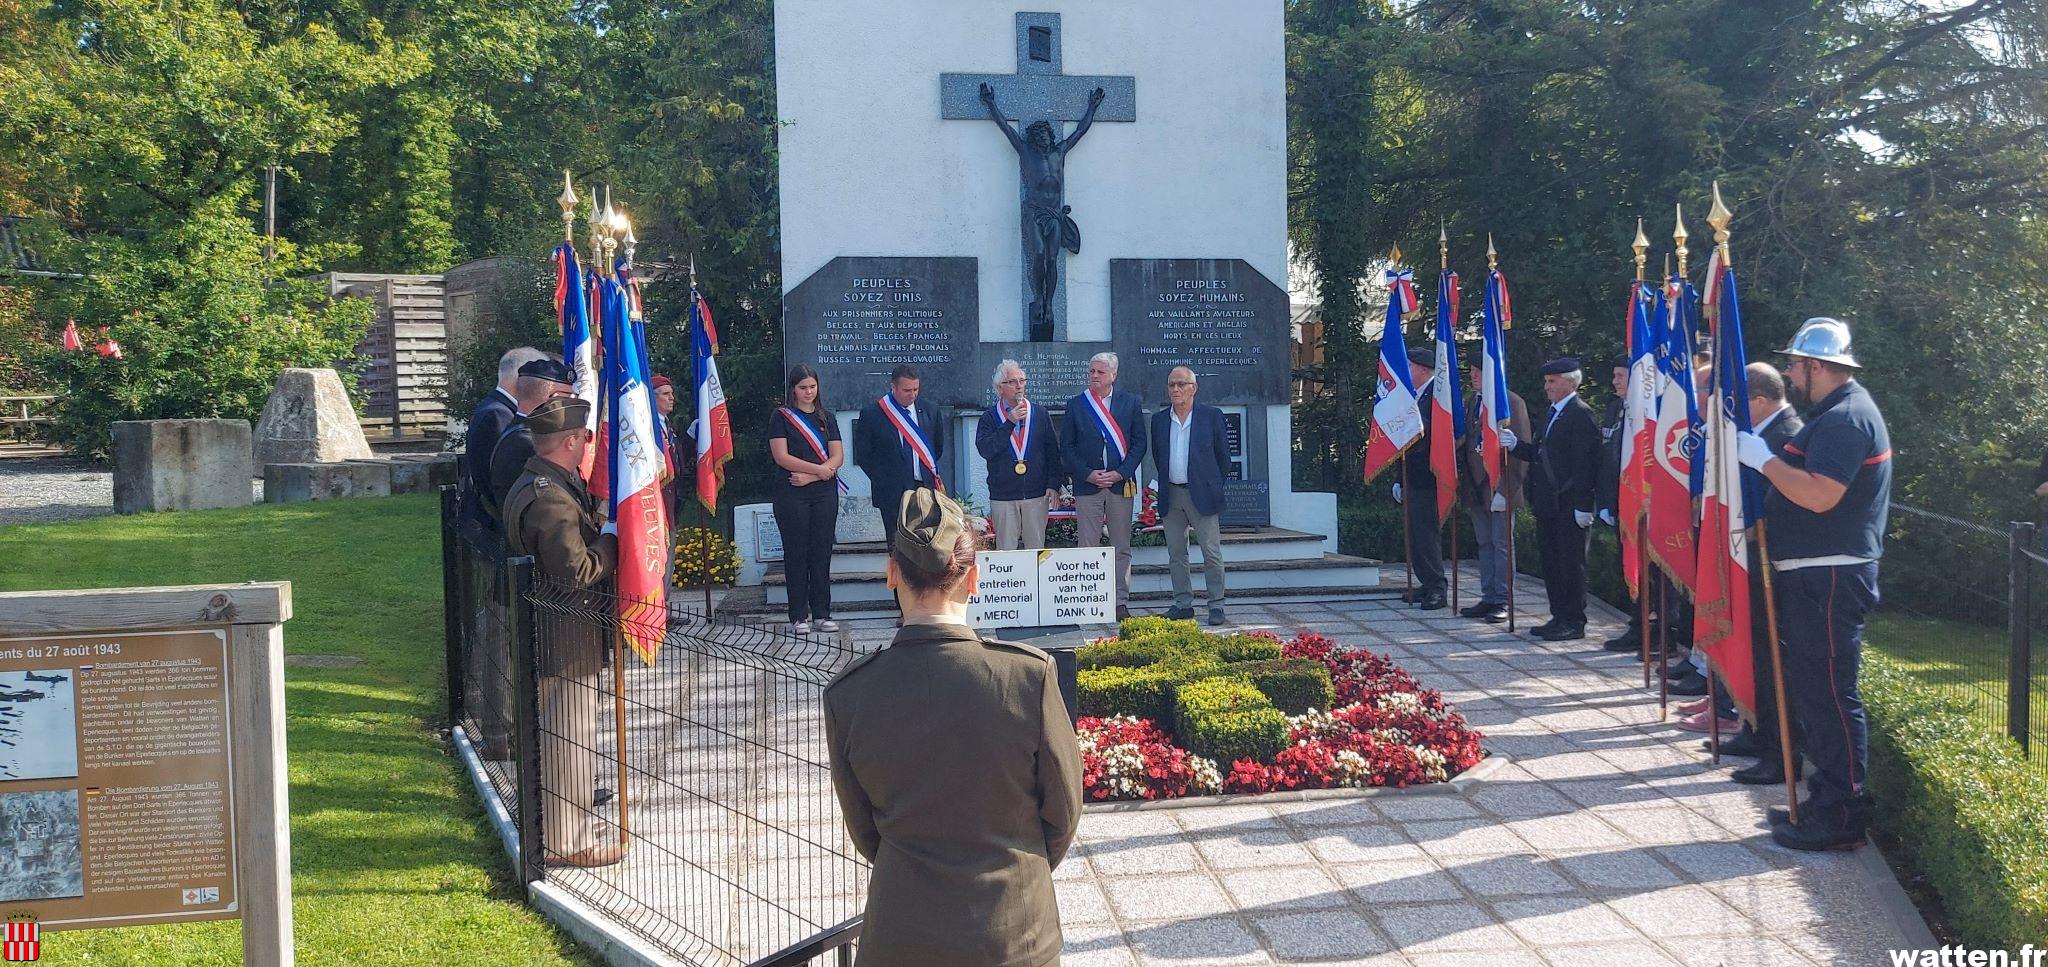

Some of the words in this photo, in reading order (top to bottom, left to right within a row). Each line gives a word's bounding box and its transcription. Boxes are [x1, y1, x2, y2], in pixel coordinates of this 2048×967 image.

[853, 278, 911, 288] PEUPLES
[1176, 280, 1226, 289] PEUPLES
[844, 292, 883, 302] SOYEZ
[894, 292, 922, 301] UNIS
[1159, 293, 1194, 302] SOYEZ
[1200, 293, 1245, 302] HUMAINS
[1168, 310, 1211, 318] VAILLANTS
[818, 356, 850, 364] RUSSES
[639, 477, 661, 574] VEUVES
[989, 563, 1014, 573] Pour
[1055, 561, 1079, 571] Voor
[1083, 561, 1100, 570] het
[1048, 572, 1106, 583] onderhoud
[1058, 584, 1077, 593] van
[1080, 582, 1097, 592] het
[984, 593, 1033, 604] Memorial
[1054, 592, 1108, 604] Memoriaal
[984, 609, 1019, 620] MERCI
[1056, 607, 1086, 618] DANK
[1091, 607, 1098, 617] U
[26, 647, 42, 658] du
[45, 645, 60, 657] 27
[63, 644, 90, 657] août
[93, 643, 121, 655] 1943
